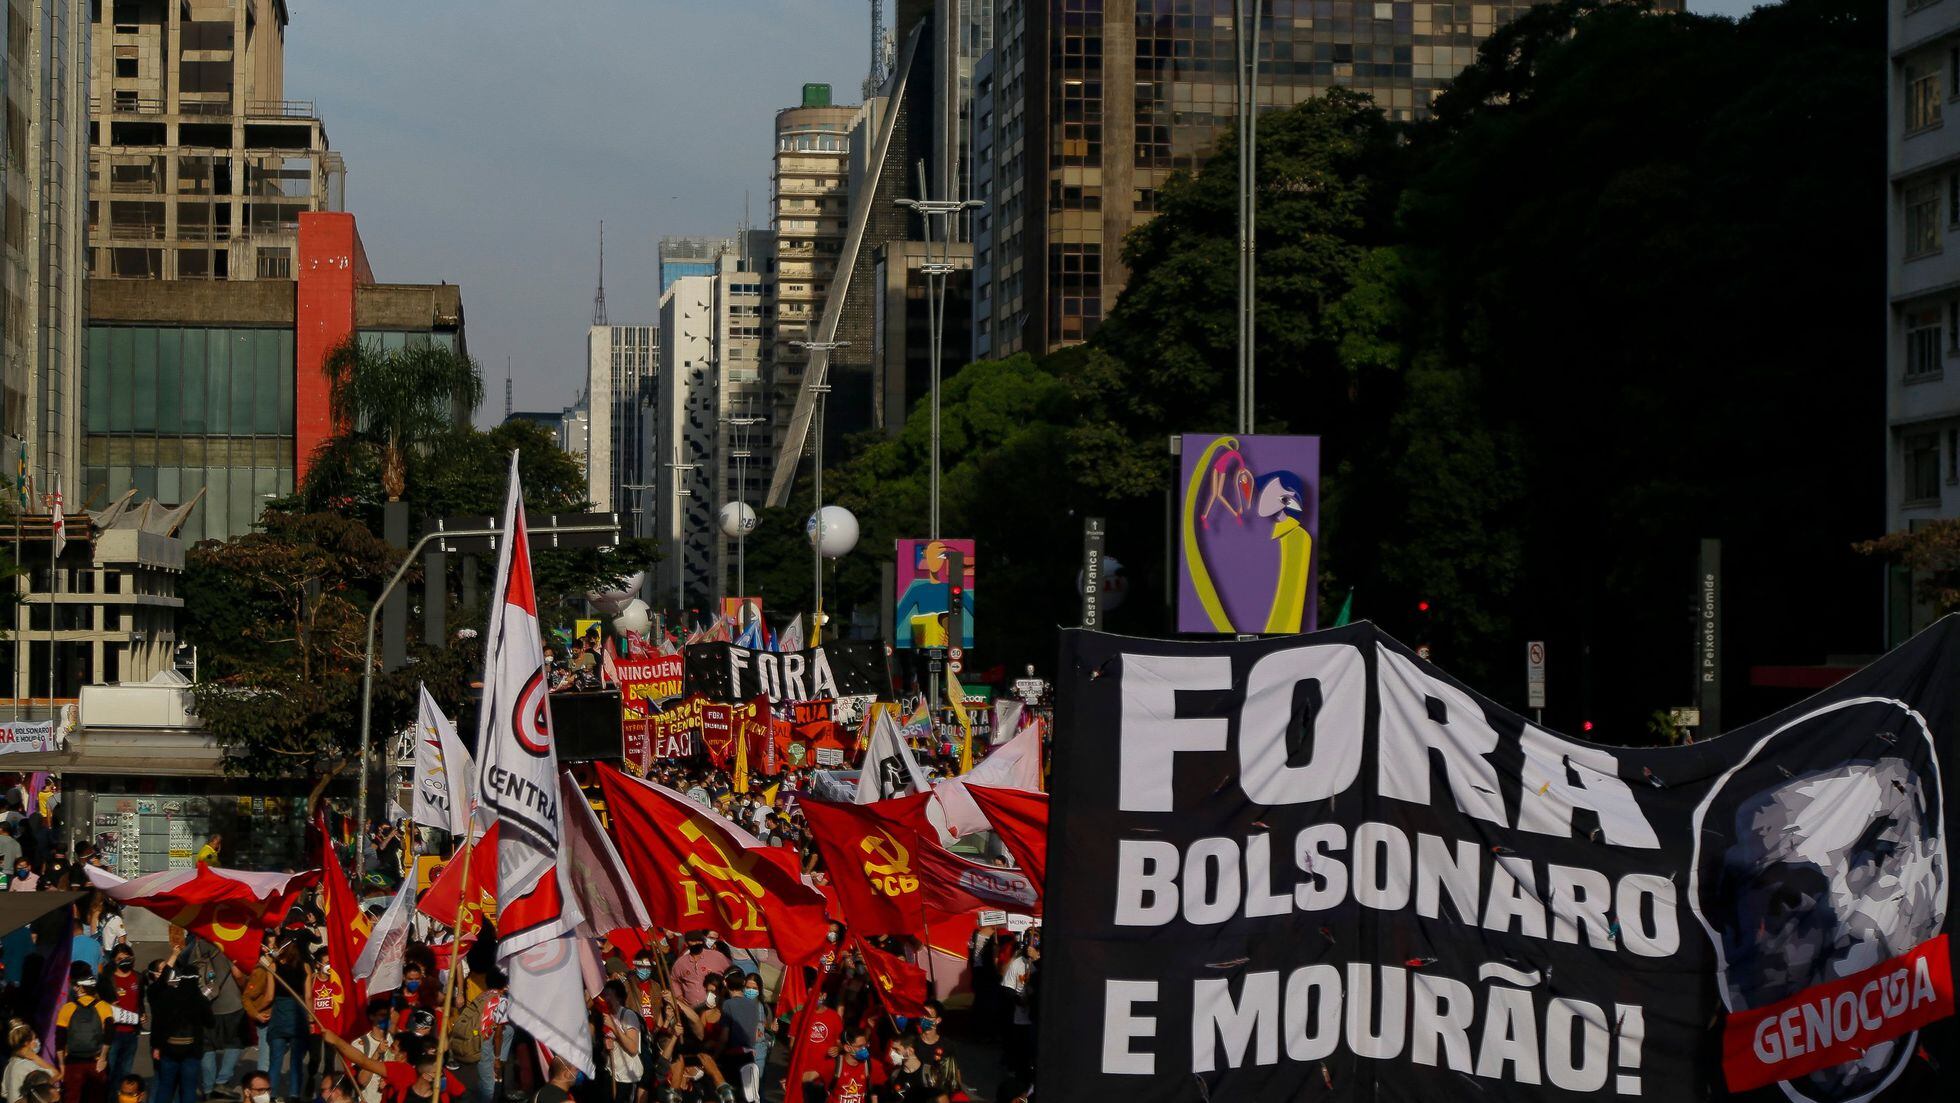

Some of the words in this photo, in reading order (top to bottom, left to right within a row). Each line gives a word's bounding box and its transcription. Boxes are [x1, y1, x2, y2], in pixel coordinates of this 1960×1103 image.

[1086, 550, 1098, 594] Branca
[1085, 596, 1096, 626] Casa
[1704, 573, 1714, 619] Gomide
[1704, 622, 1714, 667] Peixoto
[618, 661, 683, 680] NINGUÉM
[729, 646, 840, 703] FORA
[1704, 670, 1714, 682] R.
[708, 711, 725, 720] FORA
[947, 709, 989, 725] FRA
[1119, 640, 1661, 849] FORA
[1113, 821, 1681, 957] BOLSONARO
[1101, 979, 1159, 1075] E
[1192, 961, 1646, 1095] MOURÃO!
